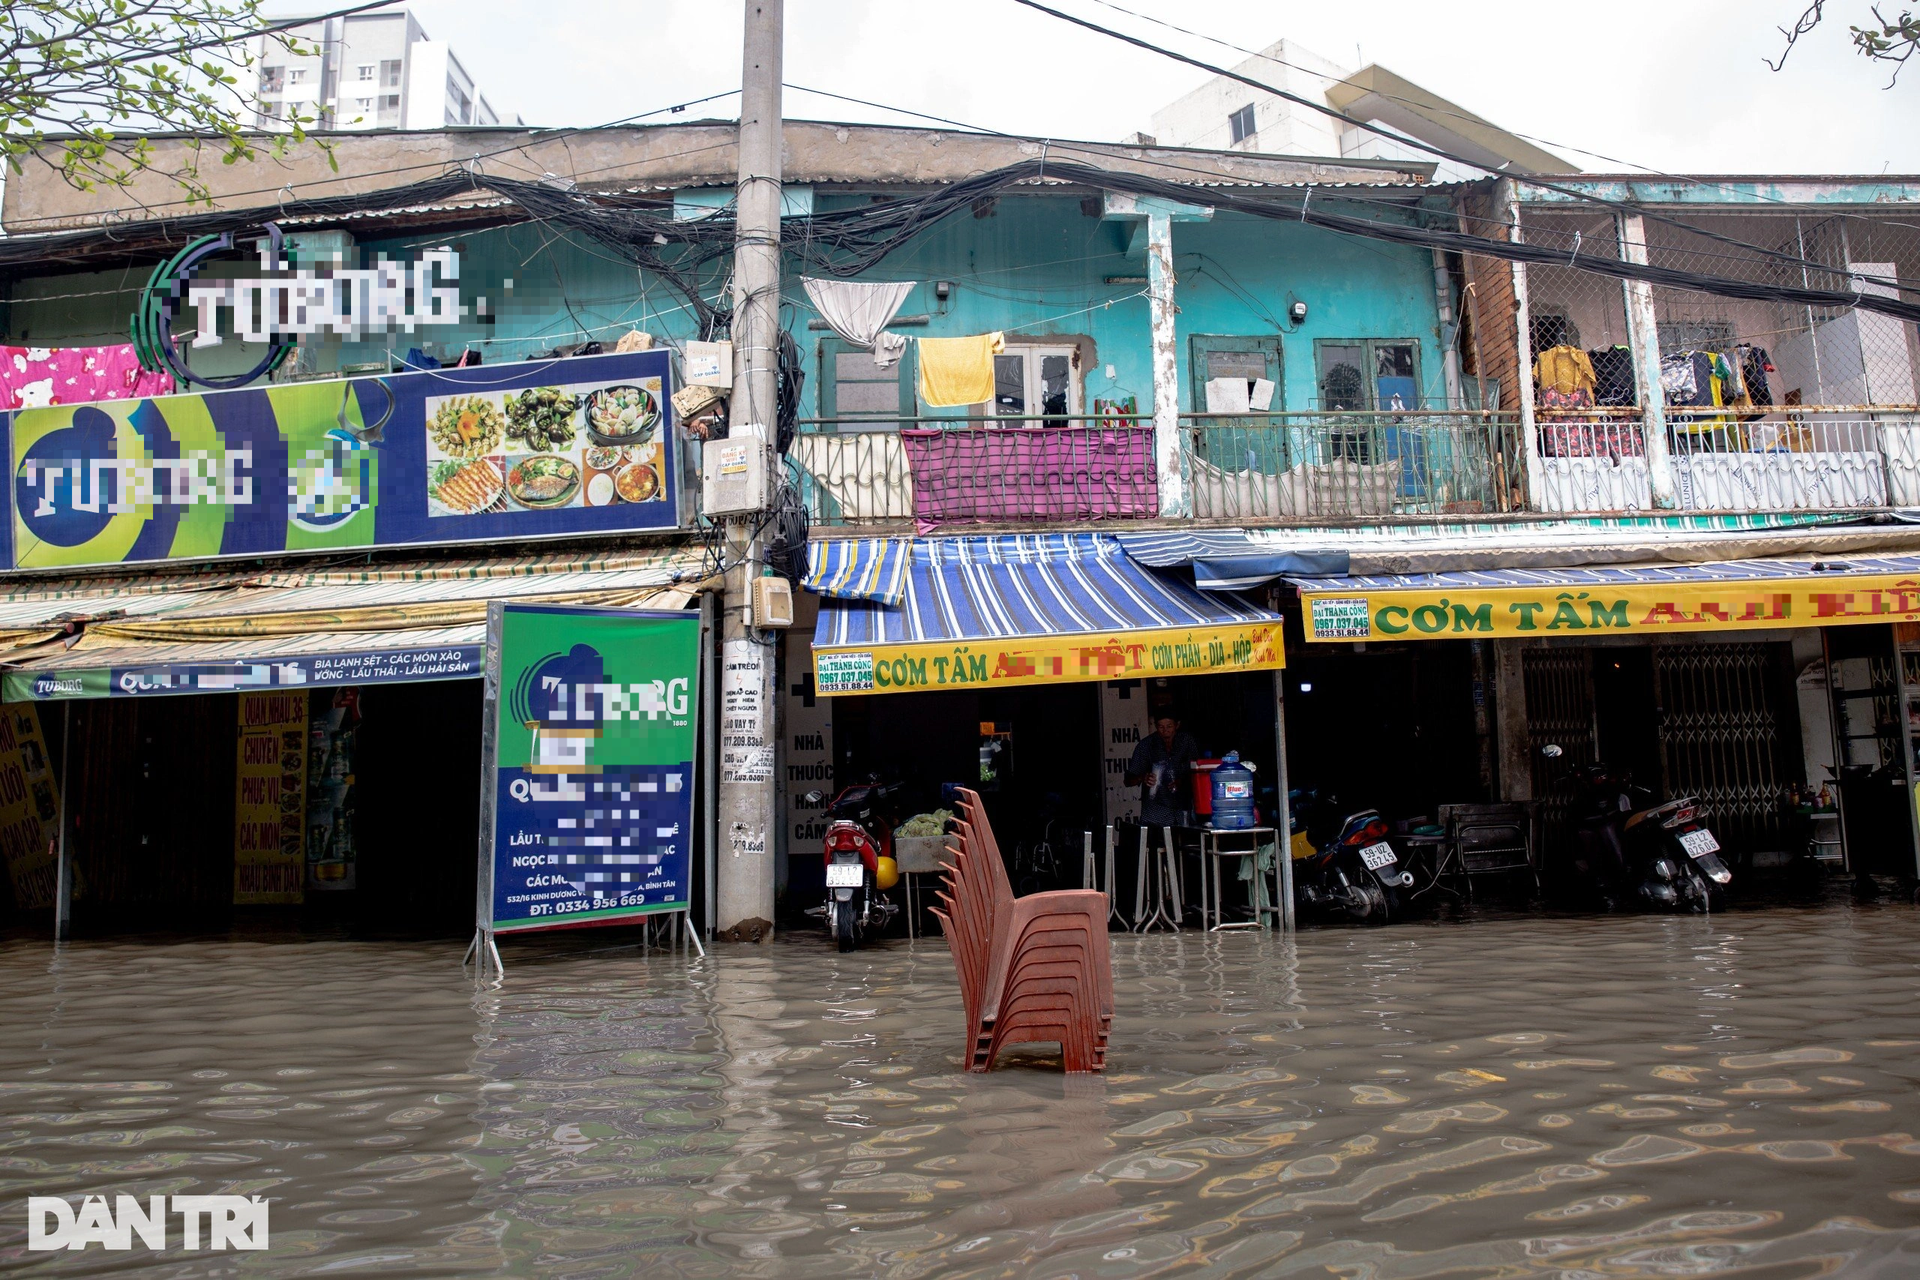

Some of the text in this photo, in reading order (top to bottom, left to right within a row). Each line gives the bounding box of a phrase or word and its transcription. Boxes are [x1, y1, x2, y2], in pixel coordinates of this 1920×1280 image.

[1314, 604, 1367, 618] ĐẠI THÀNH CÔNG
[1374, 592, 1632, 634] CƠM TẤM
[1314, 617, 1369, 630] 0967.037.045
[1315, 628, 1369, 637] 0933.51.88.44
[315, 650, 462, 671] BIA LẠNH SỆT CÁC MÓN XÀO
[1152, 632, 1252, 671] CƠM PHẦN DĨA HỘP
[374, 666, 398, 677] THÁI
[429, 662, 446, 673] HẢI
[448, 661, 470, 672] SẢN
[818, 658, 872, 672] ĐẠI THÀNH CÔNG
[875, 653, 929, 687] CƠM
[933, 647, 989, 683] TẤM
[38, 679, 82, 693] TUBORG
[819, 670, 873, 684] 0967.037.045
[820, 682, 873, 691] 0933.51.88.44
[245, 691, 266, 727] QUÁN
[269, 690, 290, 728] NHẬU
[292, 696, 303, 723] 36
[735, 719, 746, 728] VAY
[1111, 724, 1141, 743] NHÀ
[244, 730, 279, 764] CHUYÊN
[794, 730, 824, 750] NHÀ
[787, 760, 834, 781] THUỐC
[241, 777, 280, 810] PHỤC VỤ
[3, 822, 25, 862] CAO
[240, 815, 279, 850] CÁC MÓN
[512, 854, 546, 869] NGỌC
[239, 857, 300, 898] NHẬU BÌNH DÂN
[526, 874, 550, 887] CÁC
[507, 895, 530, 904] 532/16
[530, 892, 549, 902] KINH
[550, 889, 577, 900] DƯƠNG
[645, 879, 662, 890] BÌNH
[662, 880, 676, 888] TÂN
[530, 894, 645, 916] ĐT: 0334 956 669
